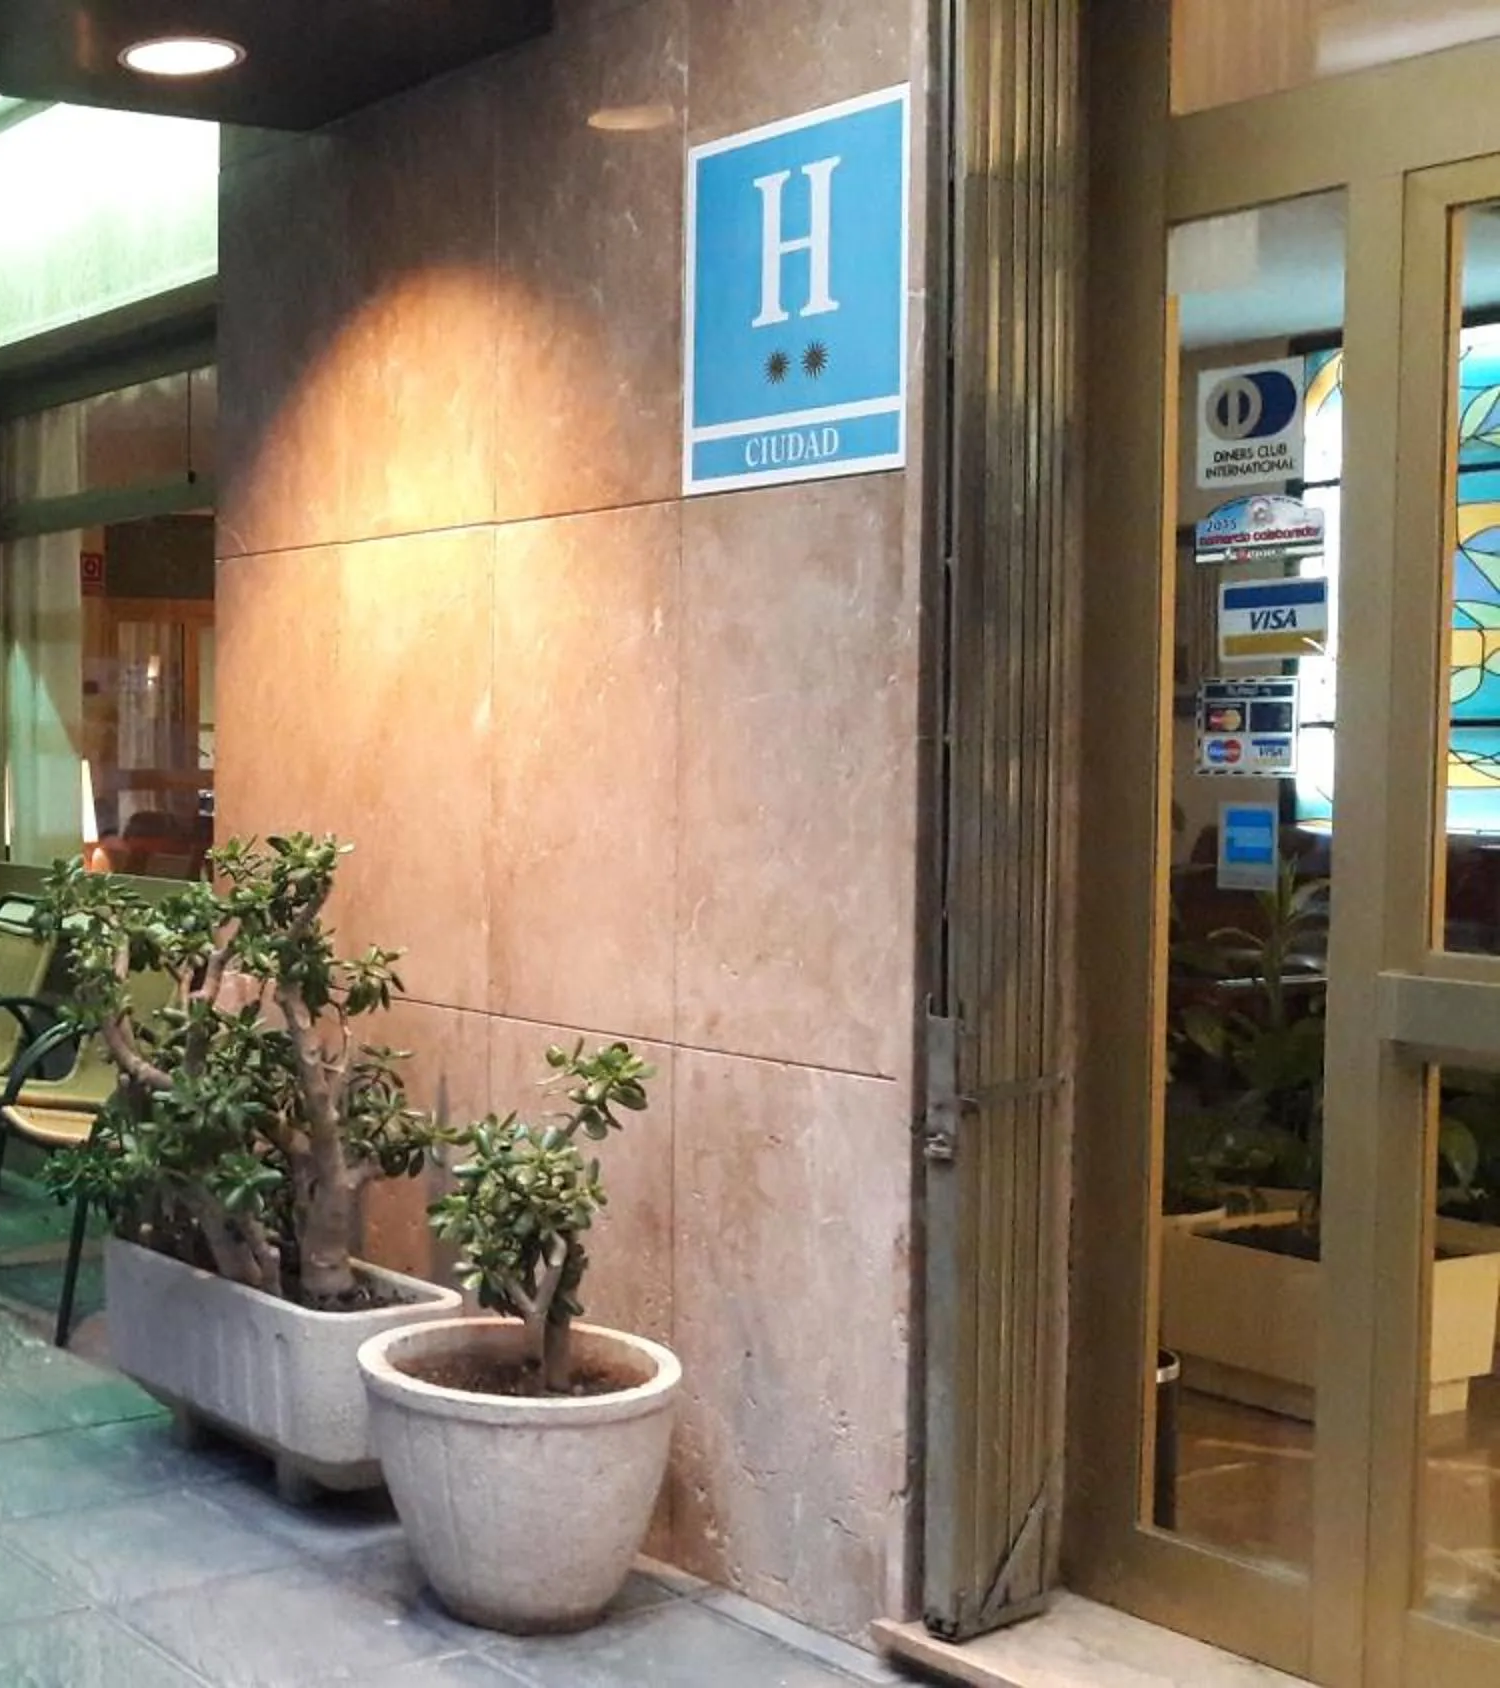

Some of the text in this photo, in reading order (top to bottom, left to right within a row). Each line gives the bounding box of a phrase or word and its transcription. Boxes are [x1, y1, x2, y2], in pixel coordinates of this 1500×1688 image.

[752, 155, 841, 328] H
[745, 427, 839, 467] CIUDAD
[1213, 443, 1288, 463] DINERS CLUB
[1205, 457, 1294, 479] INTERNATIONAL
[1250, 608, 1297, 631] VISA
